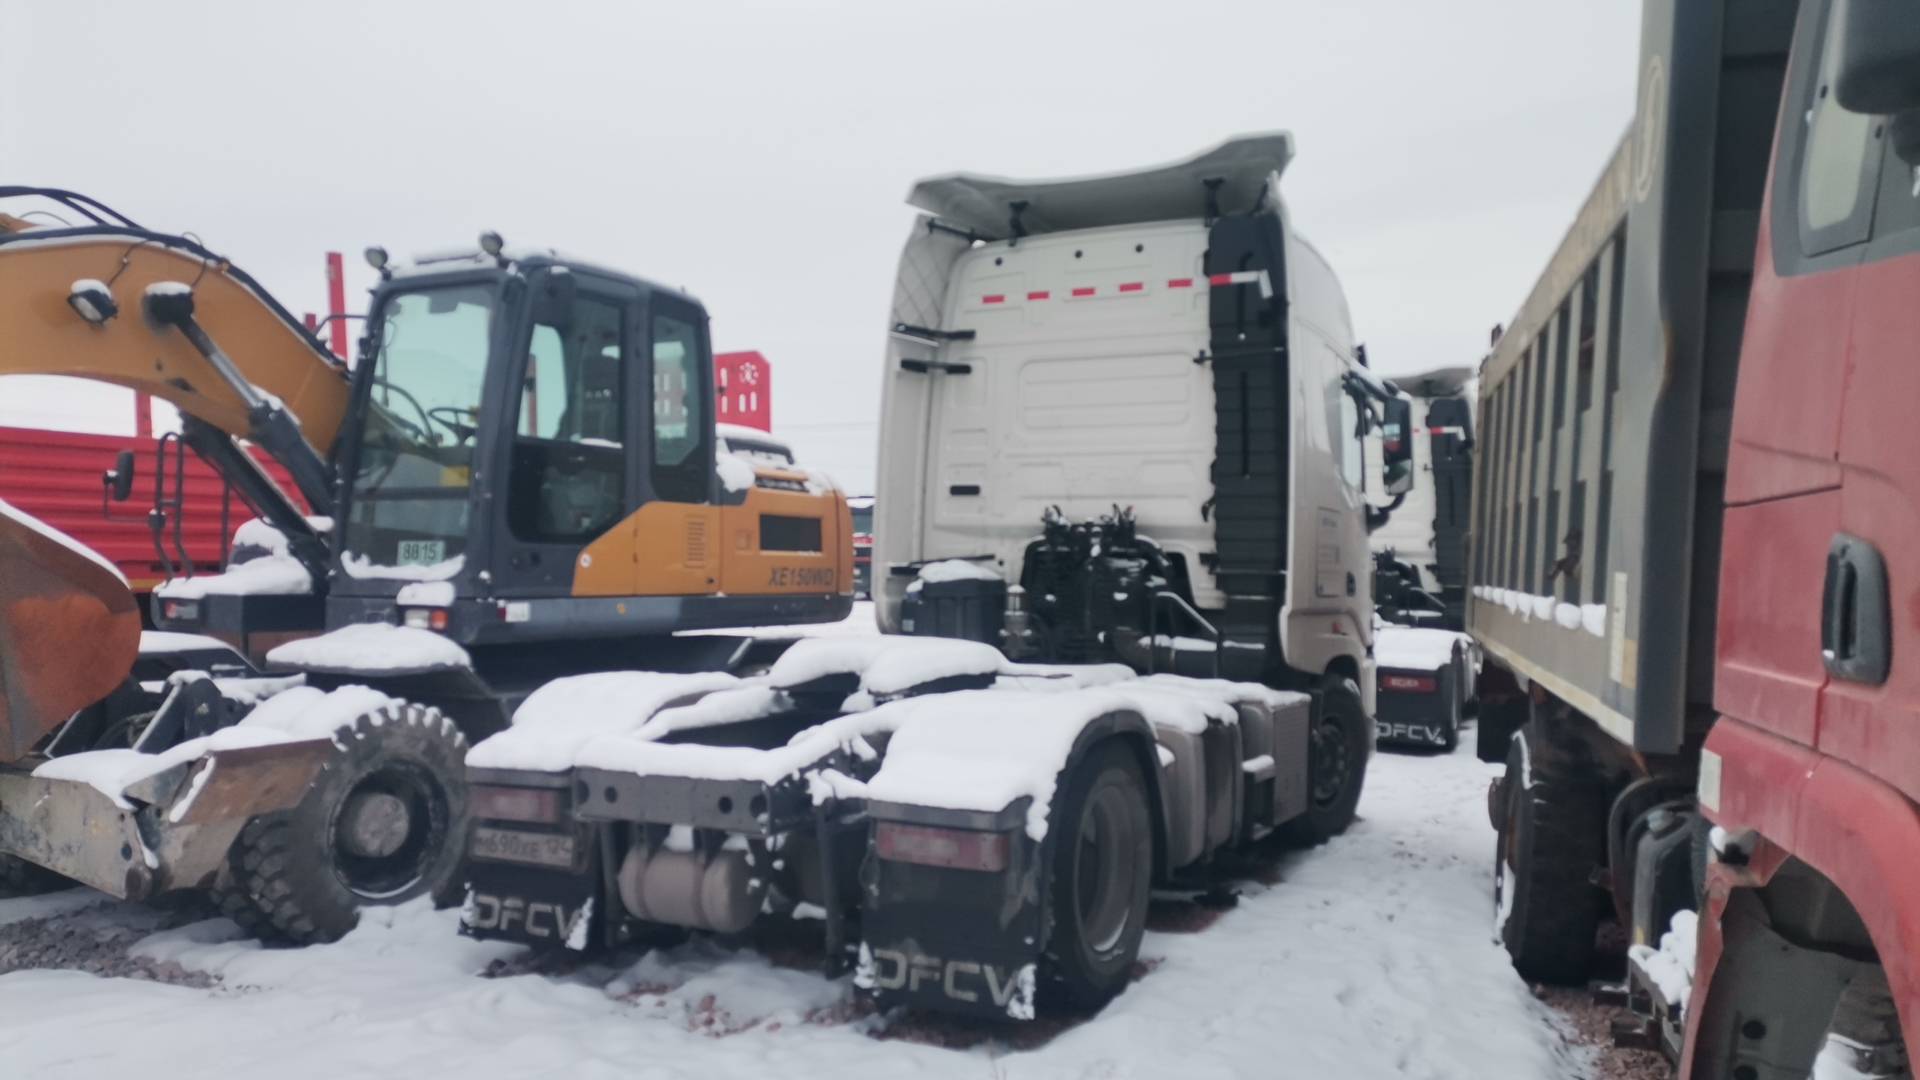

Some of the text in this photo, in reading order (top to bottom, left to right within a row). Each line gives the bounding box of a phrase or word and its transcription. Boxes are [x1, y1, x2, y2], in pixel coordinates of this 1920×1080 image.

[1376, 721, 1441, 741] DFCV
[473, 894, 583, 940] DFCV
[873, 948, 1020, 1007] DFCV
